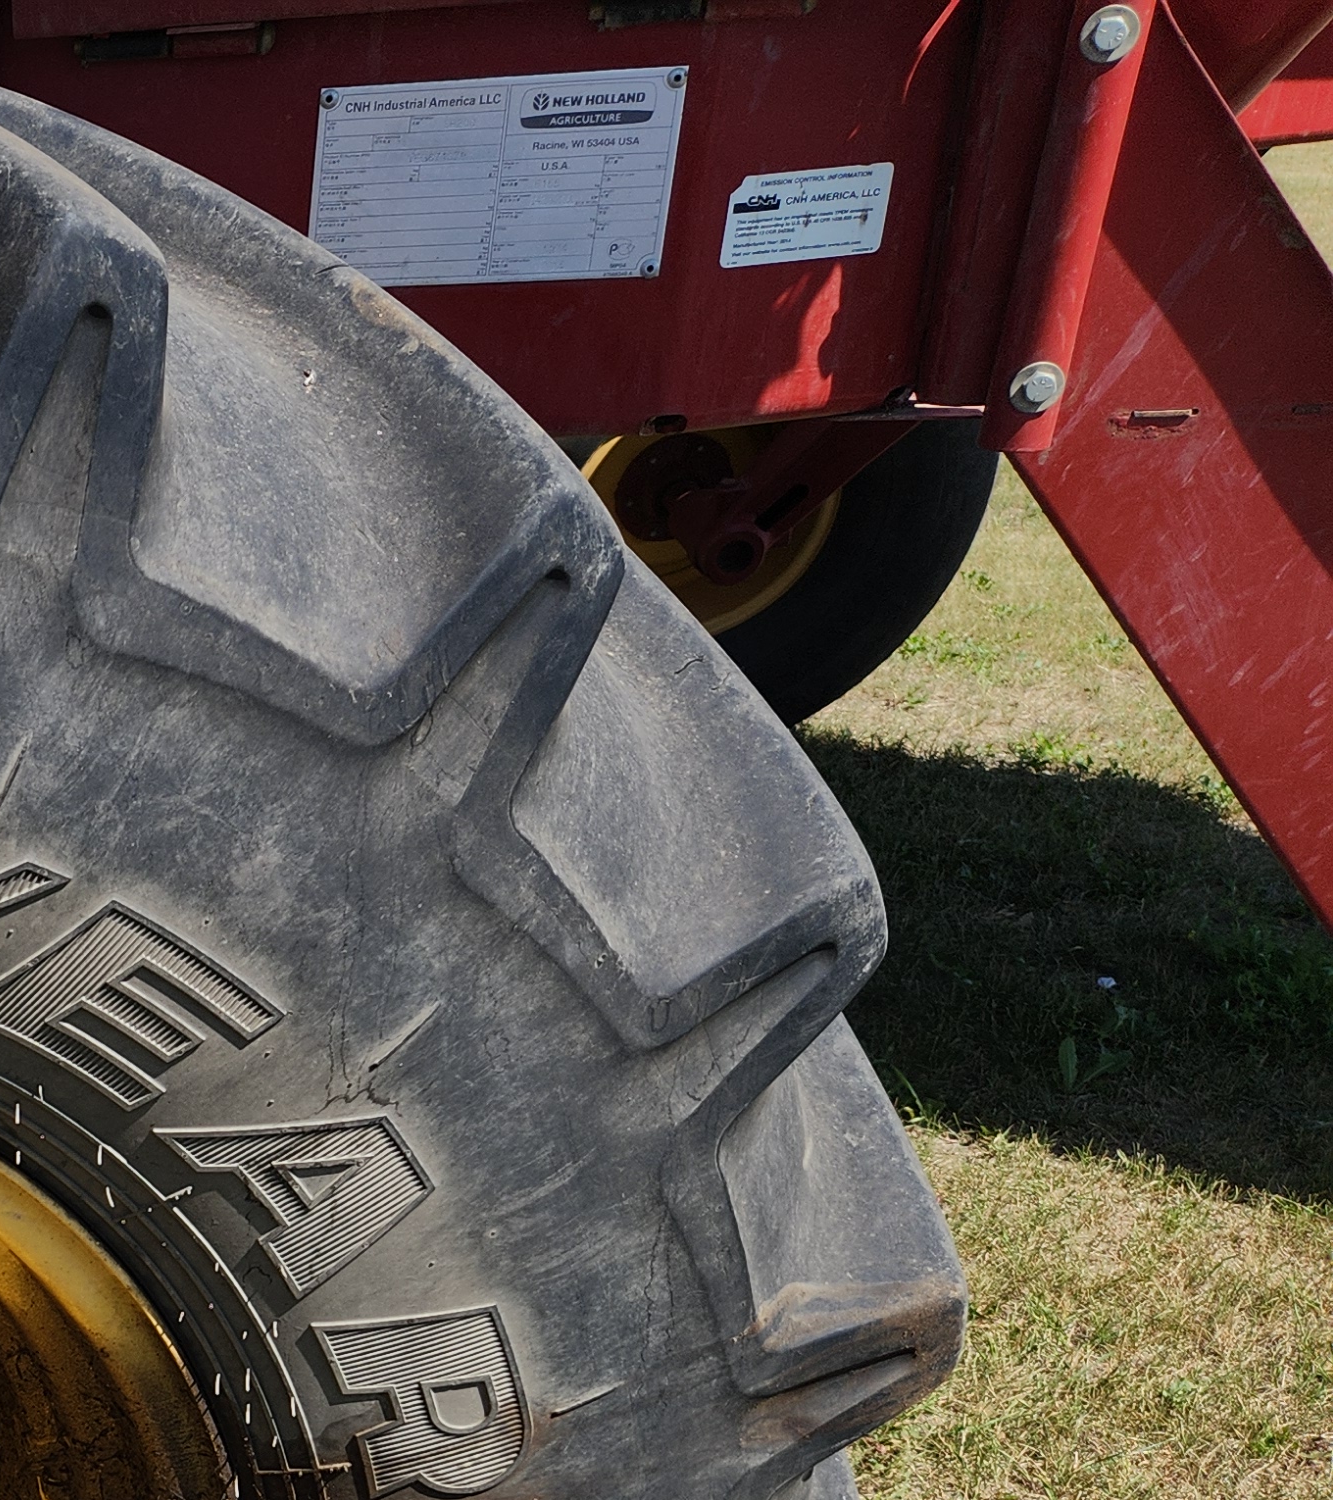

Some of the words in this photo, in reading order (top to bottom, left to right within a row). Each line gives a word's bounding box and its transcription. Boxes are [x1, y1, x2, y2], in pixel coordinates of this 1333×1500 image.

[345, 101, 371, 114] CNH
[373, 98, 427, 112] Industrial
[428, 96, 476, 108] America
[479, 93, 502, 105] LLC
[552, 95, 584, 108] NEW
[585, 92, 646, 105] HOLLAND
[549, 112, 622, 126] AGRICULTURE
[532, 139, 569, 151] Racine,
[571, 139, 584, 148] WI
[587, 137, 616, 148] 53404
[618, 136, 640, 147] USA
[761, 178, 793, 188] EMISSION
[794, 175, 826, 184] CONTROL
[827, 170, 874, 181] INFORMATION
[747, 193, 781, 207] CNH
[785, 196, 808, 206] CNH
[809, 191, 860, 204] AMERICA,
[862, 187, 881, 198] LLC
